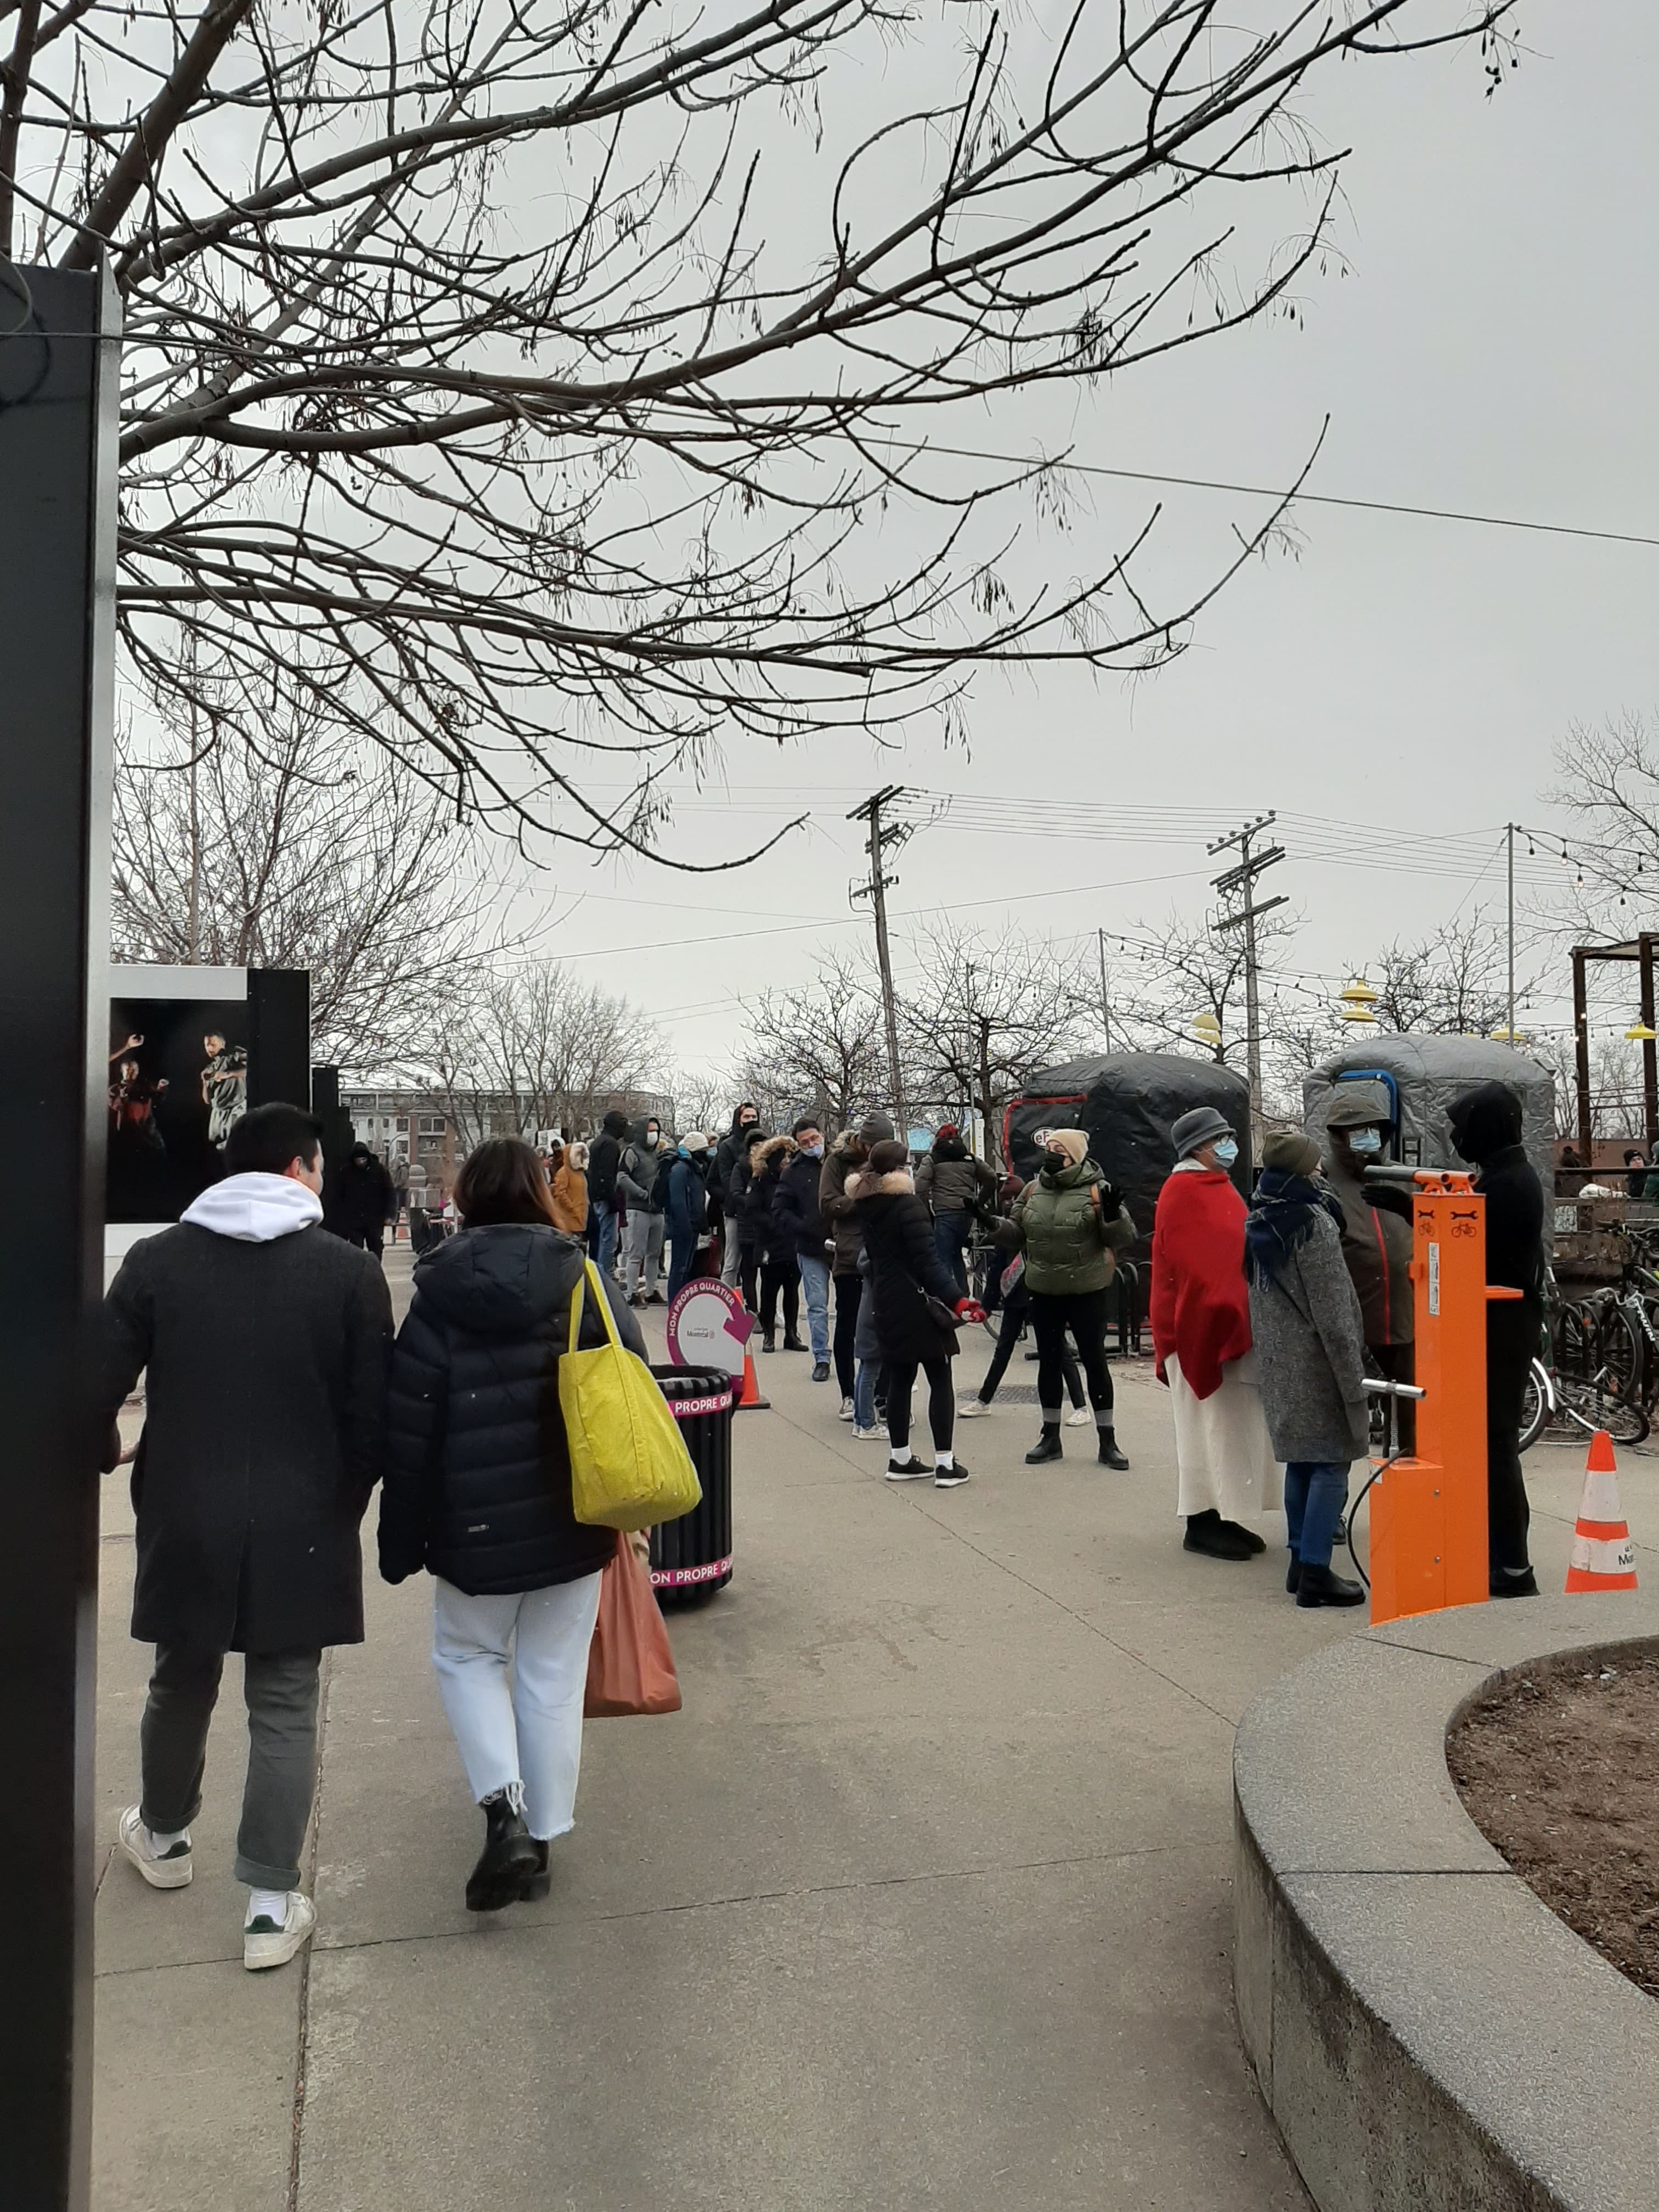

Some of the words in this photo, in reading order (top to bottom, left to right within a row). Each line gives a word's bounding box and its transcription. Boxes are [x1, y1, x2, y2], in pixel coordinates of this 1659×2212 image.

[1036, 1131, 1050, 1143] eF
[669, 1312, 678, 1336] MON
[674, 1284, 698, 1312] PROPRE
[699, 1283, 735, 1306] QUARTIER
[675, 1397, 718, 1413] PROPRE
[650, 1573, 670, 1584] ON
[676, 1564, 718, 1582] PROPRE
